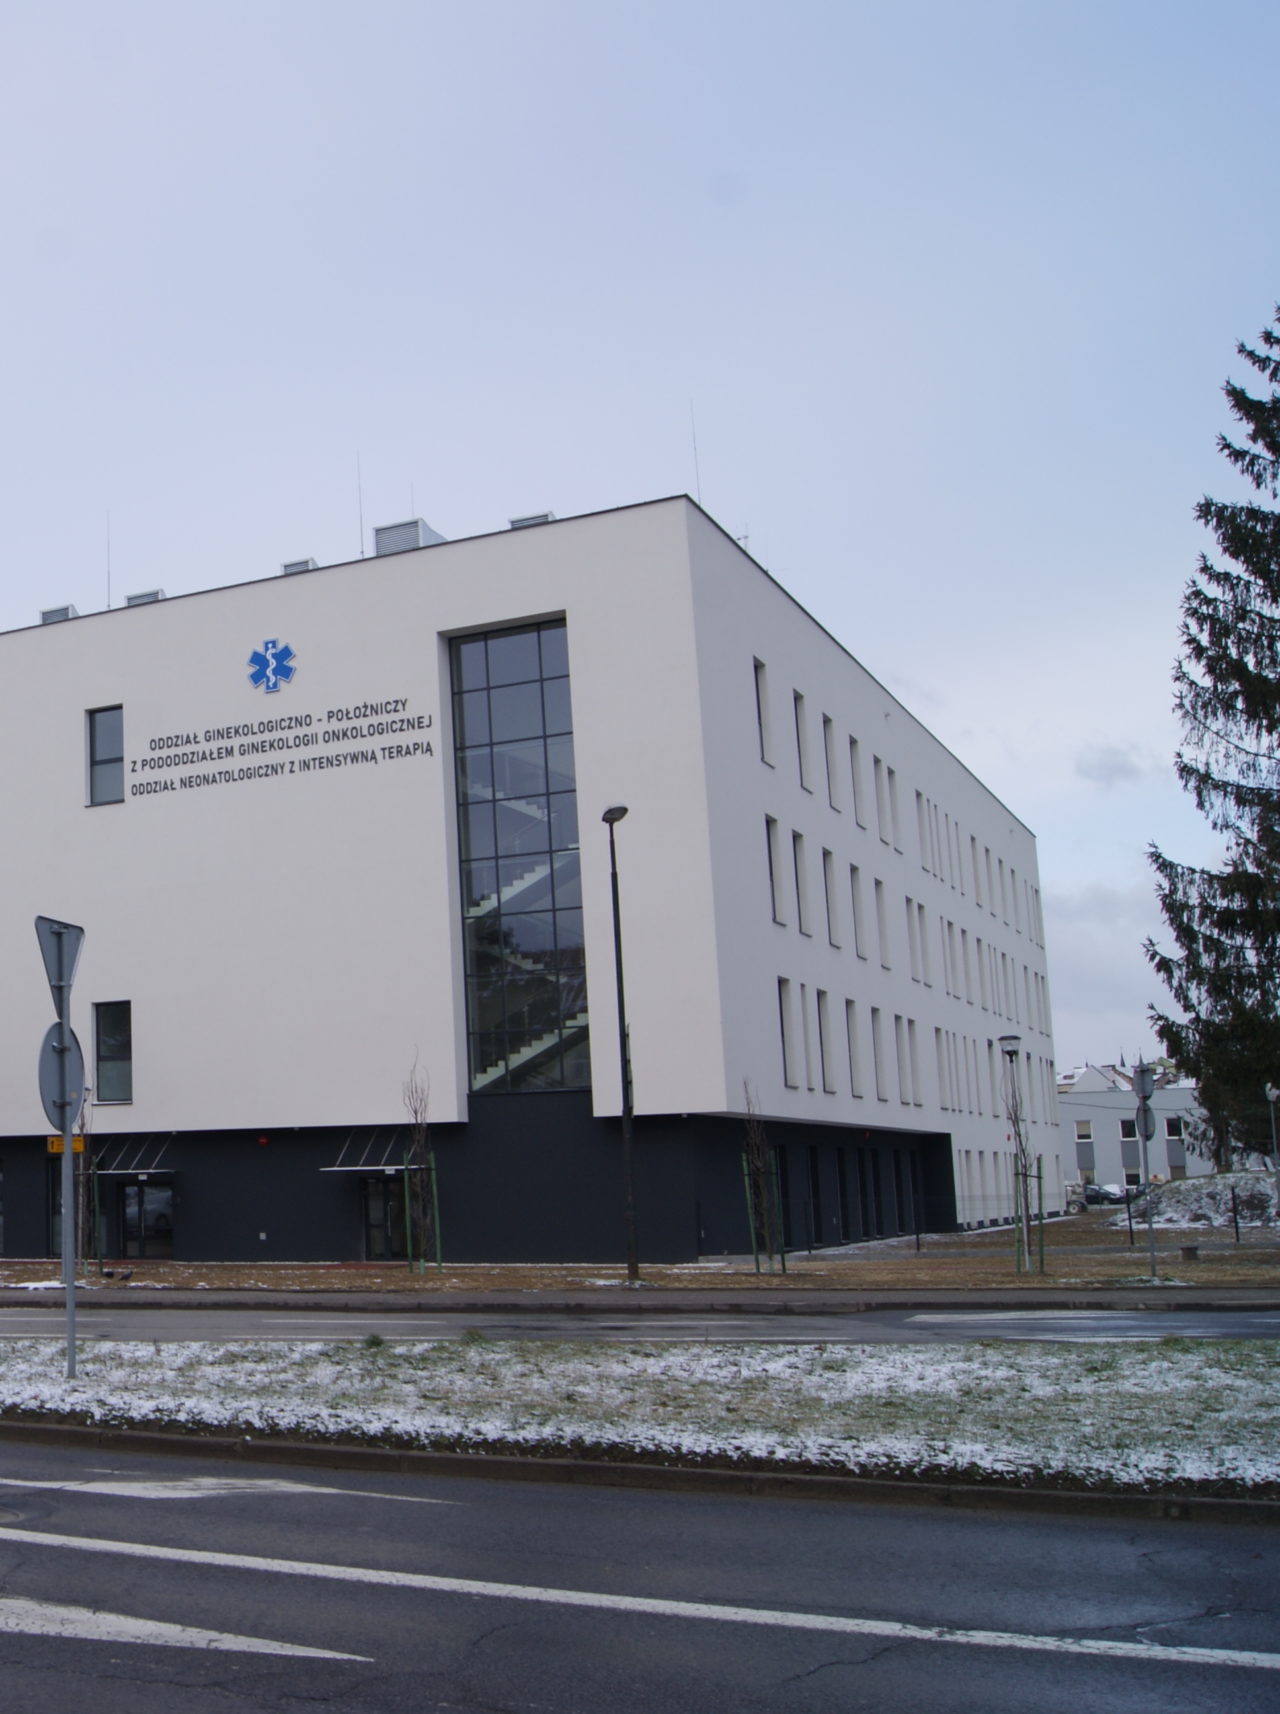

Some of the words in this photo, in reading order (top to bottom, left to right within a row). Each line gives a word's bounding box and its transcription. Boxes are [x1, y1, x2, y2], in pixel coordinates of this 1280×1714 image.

[131, 760, 138, 773] Z
[141, 745, 235, 771] PODODDZIAŁEM
[238, 732, 319, 756] GINEKOLOGII
[323, 714, 433, 743] ONKOLOGICZNEJ
[149, 732, 201, 751] ODDZIAŁ
[204, 714, 313, 742] GINEKOLOGICZNO
[327, 698, 408, 723] POŁOŻNICZY
[131, 780, 177, 796] ODDZIAŁ
[179, 761, 286, 789] NEONATOLOGICZNY
[288, 760, 296, 774] Z
[298, 749, 378, 772] INTENSYWNĄ
[380, 741, 434, 761] TERAPIĄ
